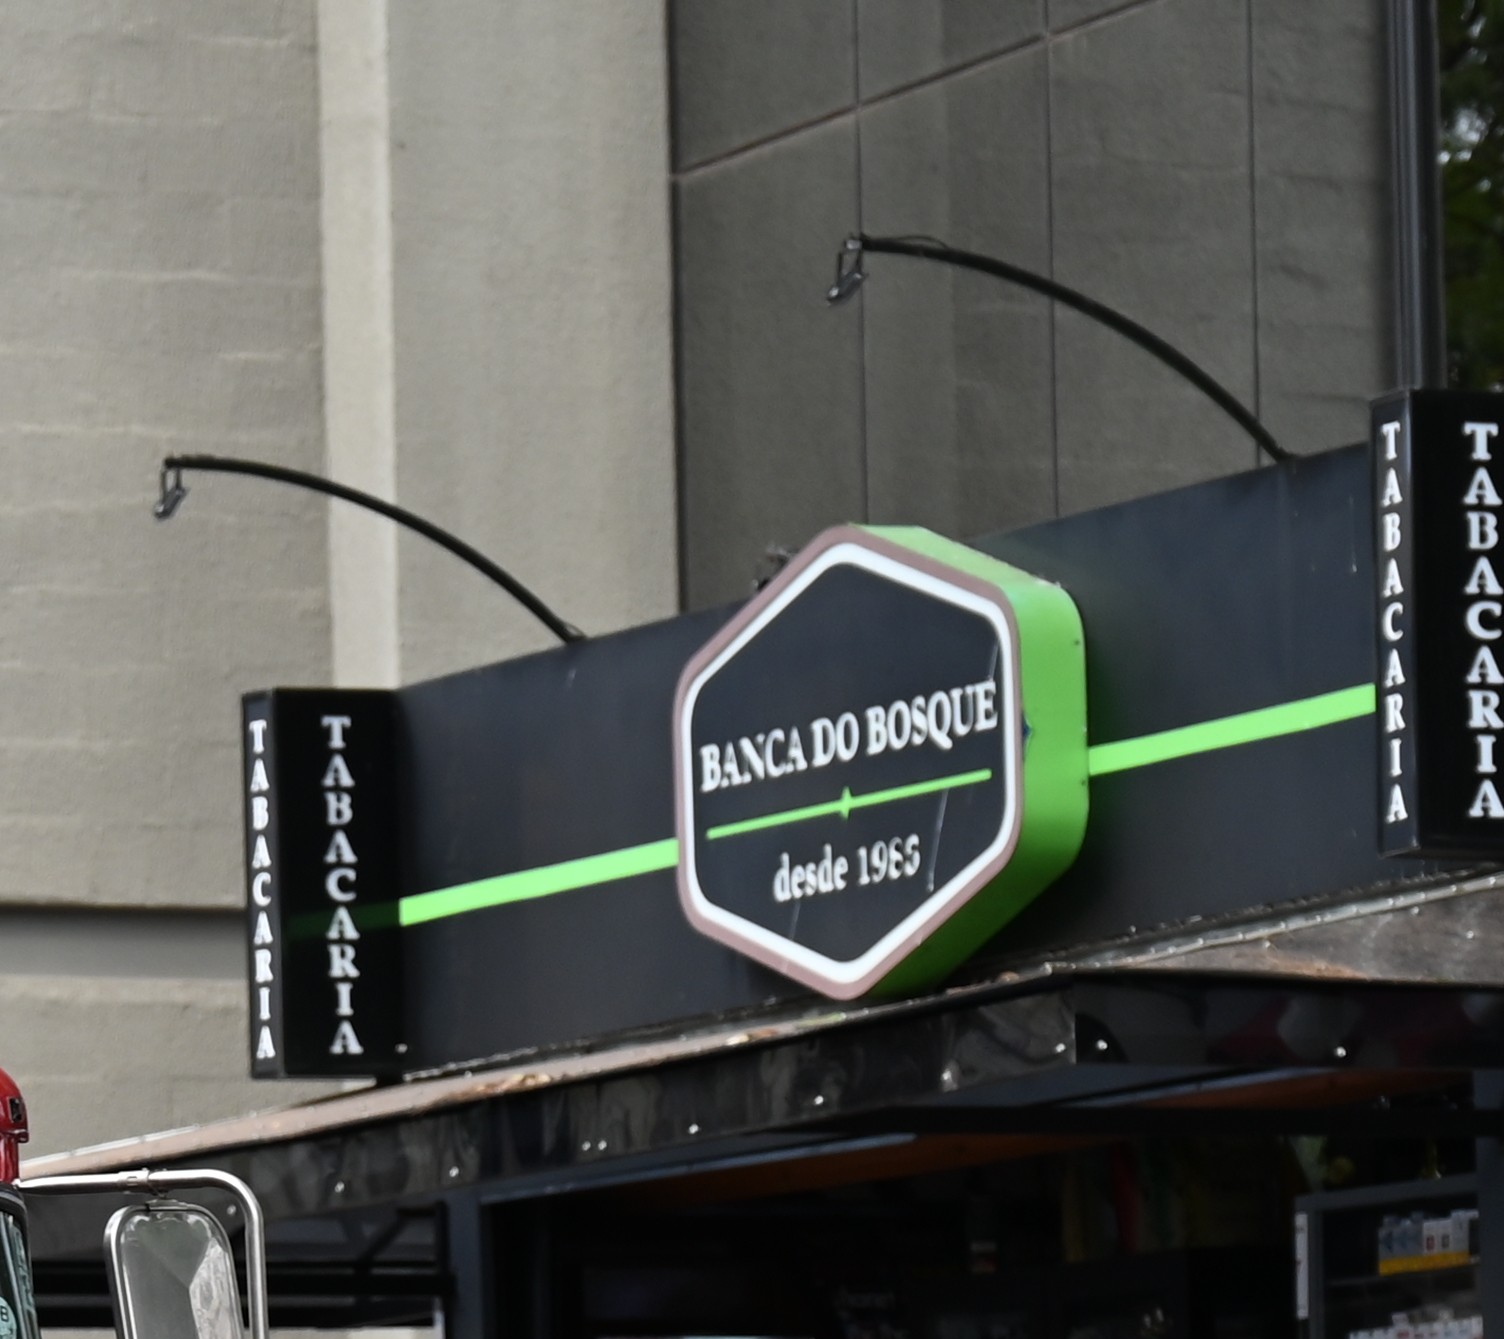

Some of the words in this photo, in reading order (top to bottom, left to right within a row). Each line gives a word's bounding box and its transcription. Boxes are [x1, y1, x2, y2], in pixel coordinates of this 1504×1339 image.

[699, 726, 809, 793] BANCA
[809, 711, 861, 769] DO
[864, 679, 999, 757] BOSQUE
[1381, 420, 1408, 824] TABACARIA
[248, 718, 276, 1060] TABACARIA
[320, 714, 364, 1055] TABACARIA
[772, 842, 849, 903] desde
